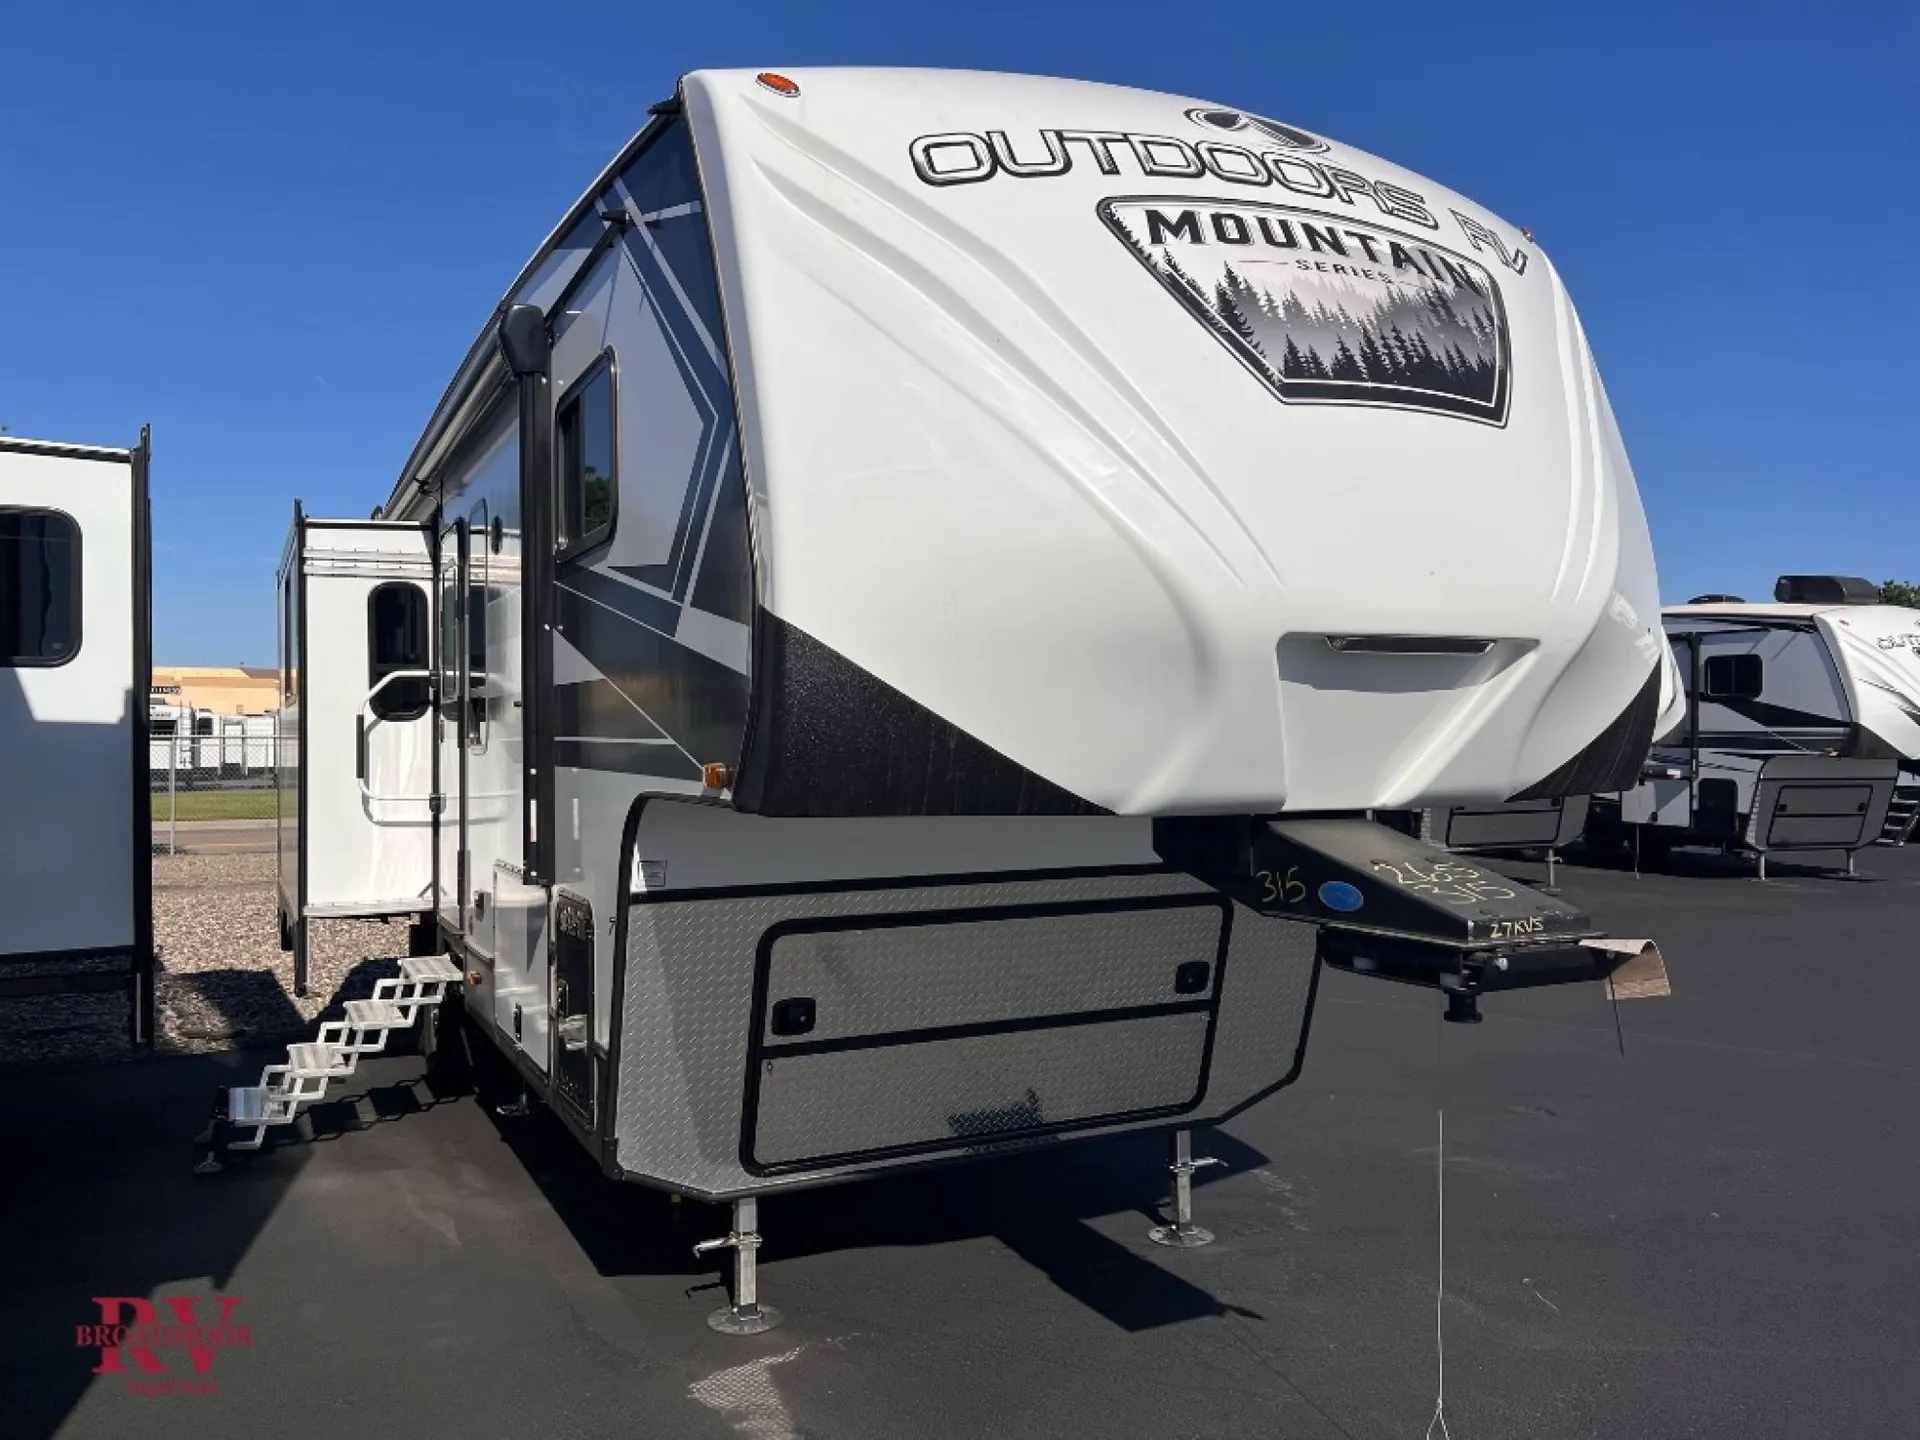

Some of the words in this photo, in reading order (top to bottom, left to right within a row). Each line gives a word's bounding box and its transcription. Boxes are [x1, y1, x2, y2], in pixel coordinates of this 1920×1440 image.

[909, 129, 1439, 231] OUTDOORS
[1145, 208, 1484, 298] MOUNTAIN
[1295, 259, 1395, 285] SERIES
[1256, 865, 1306, 903] 315
[1489, 916, 1545, 940] 27KVS
